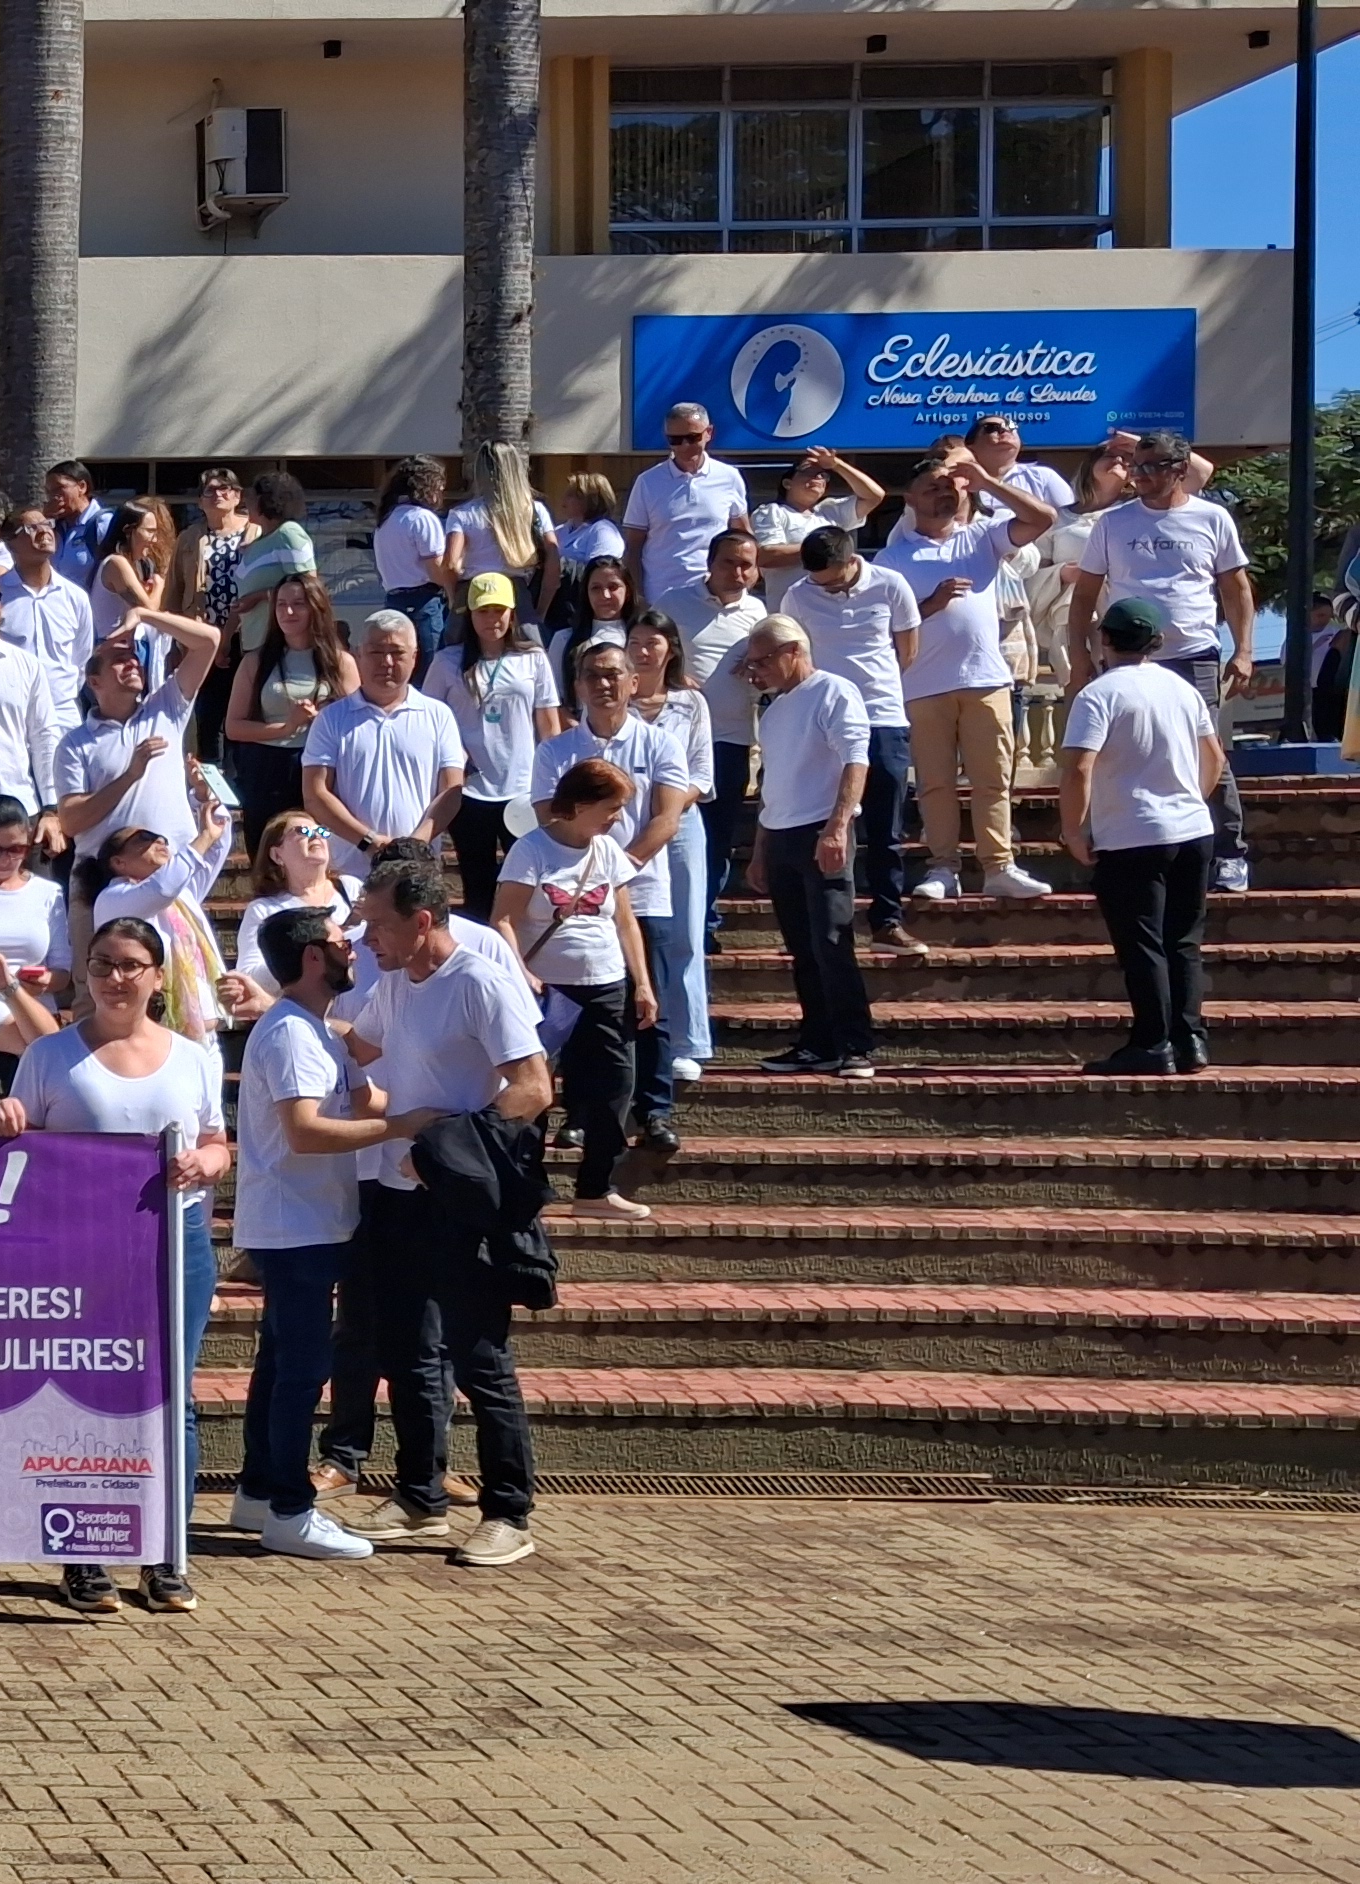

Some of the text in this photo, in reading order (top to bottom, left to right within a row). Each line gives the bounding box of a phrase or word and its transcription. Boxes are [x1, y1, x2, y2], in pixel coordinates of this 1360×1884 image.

[868, 333, 1098, 383] Eclesiástica
[868, 383, 1098, 406] Nossa Senhora de Lourdes
[916, 412, 968, 425] Artigos
[22, 1456, 153, 1473] APUCARANA
[35, 1479, 87, 1489] Prefeitura
[101, 1479, 140, 1490] Cidade
[76, 1510, 131, 1524] Secretaria
[86, 1526, 131, 1542] Mulher
